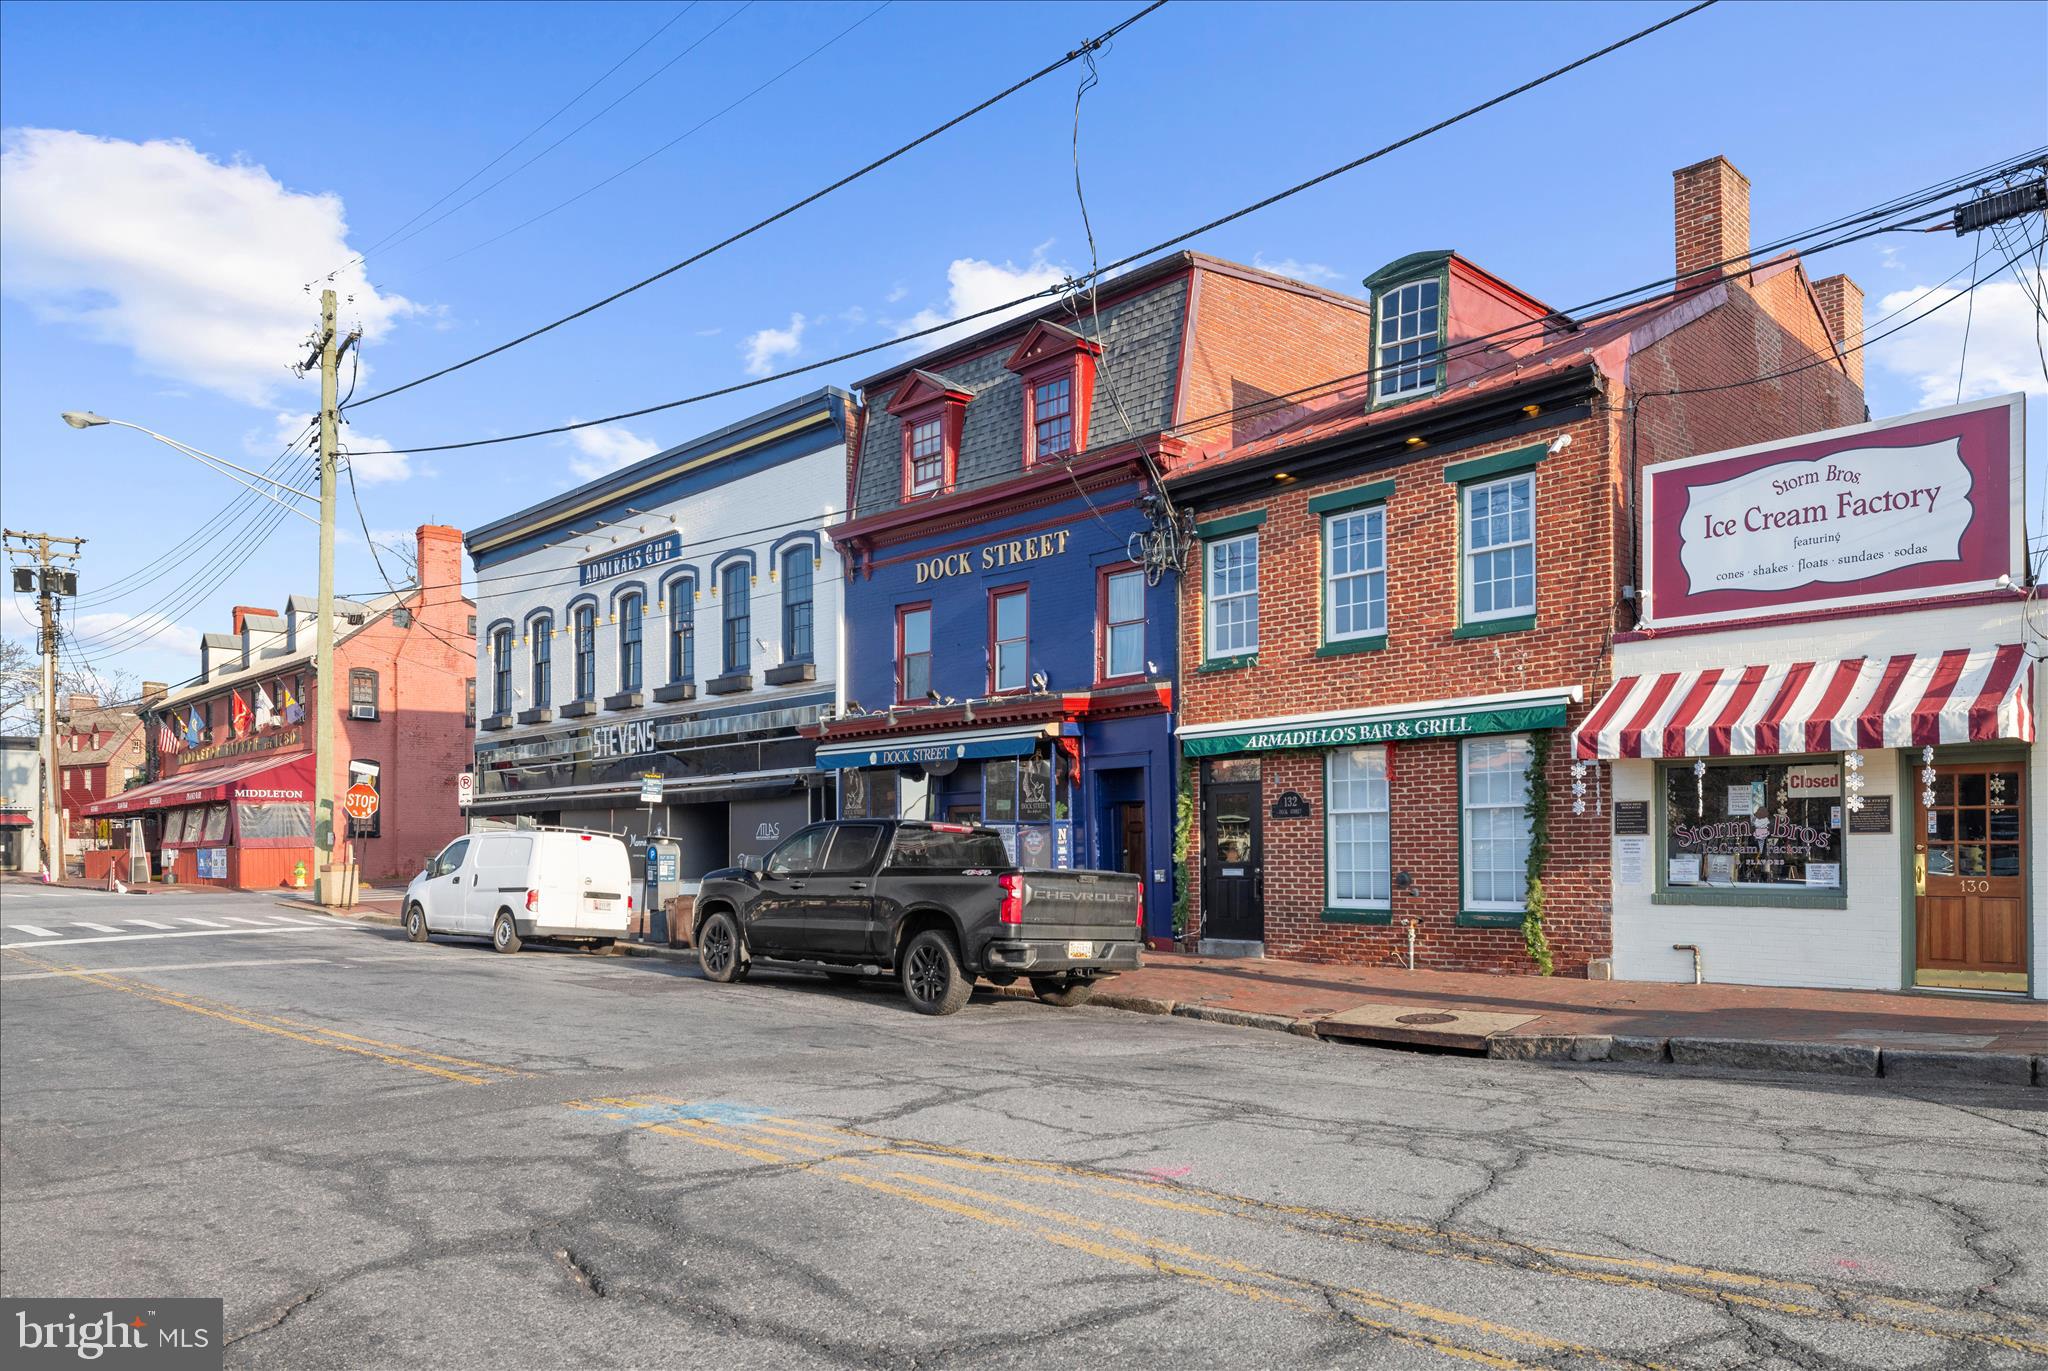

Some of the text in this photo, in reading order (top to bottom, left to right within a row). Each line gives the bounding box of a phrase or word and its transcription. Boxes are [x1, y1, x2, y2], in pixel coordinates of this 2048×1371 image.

[1772, 471, 1819, 496] Storm
[1703, 485, 1942, 539] Ice Cream Factory
[1793, 532, 1841, 550] featuring
[585, 540, 672, 584] ADMIRAL'S CUP
[915, 529, 1070, 584] DOCK STREET
[1716, 543, 1928, 581] cones shakes floats sundaes sodas
[593, 720, 656, 758] STEVENS
[1245, 716, 1472, 748] ARMADILLO'S BAR & GRILL
[883, 746, 951, 764] DOCK STREET
[1790, 774, 1839, 789] Closed
[234, 789, 303, 798] MIDDLETON
[346, 793, 377, 809] STOP
[1283, 796, 1298, 807] 132
[1675, 821, 1751, 848] Storm
[1033, 890, 1134, 902] CHEVROLET
[1960, 880, 1990, 893] 130
